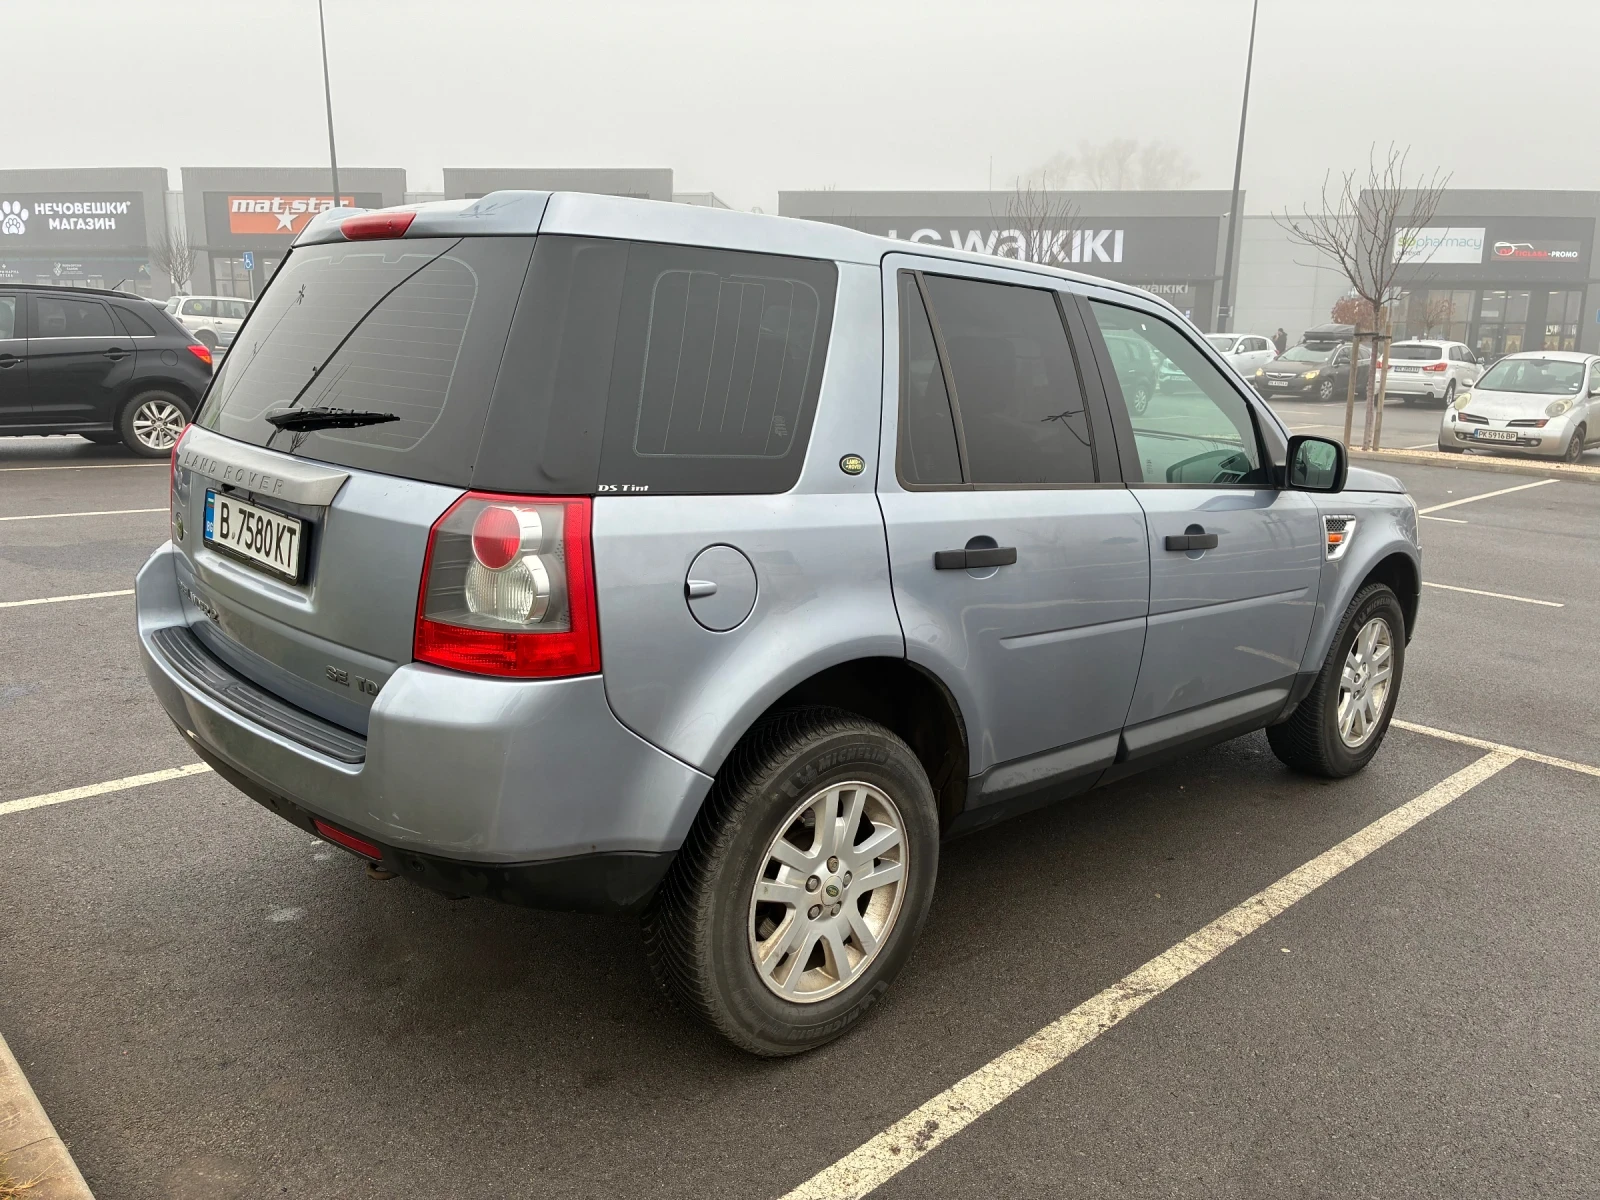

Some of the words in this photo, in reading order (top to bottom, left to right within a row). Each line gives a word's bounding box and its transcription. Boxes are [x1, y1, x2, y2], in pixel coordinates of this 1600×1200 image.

[35, 202, 128, 215] НЕЧОВЕШКИ
[231, 197, 284, 213] mat
[49, 217, 116, 230] МАГАЗИН
[185, 452, 217, 476] LAND
[223, 465, 284, 496] ROVER
[598, 484, 618, 492] DS
[621, 484, 649, 492] Tint
[326, 664, 350, 688] SE
